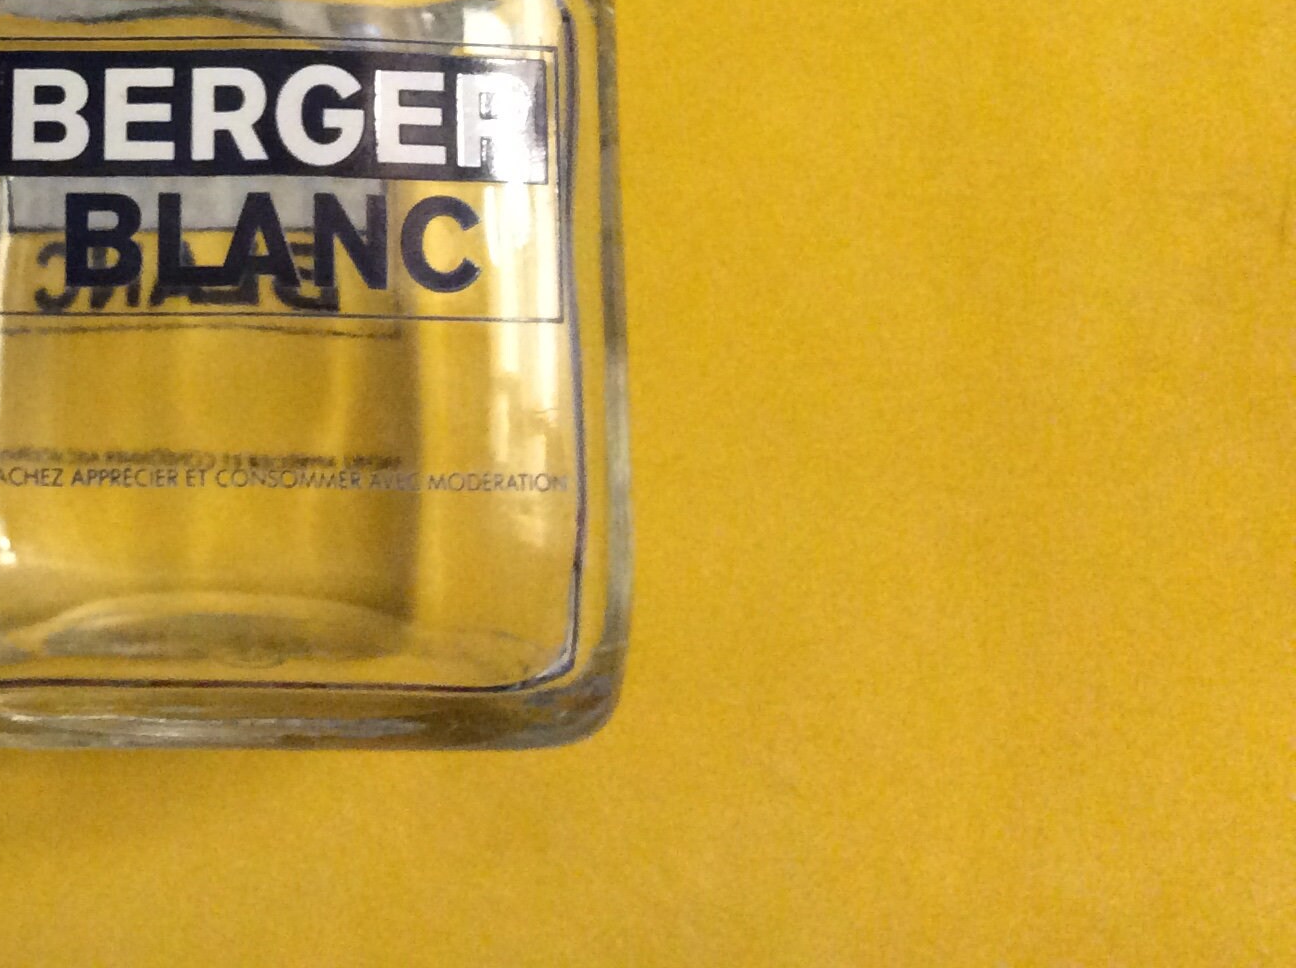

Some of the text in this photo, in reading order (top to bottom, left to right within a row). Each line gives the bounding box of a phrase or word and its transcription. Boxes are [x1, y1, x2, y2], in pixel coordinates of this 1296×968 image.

[11, 64, 533, 169] BERGER
[65, 192, 481, 293] BLANC
[186, 468, 207, 487] ET
[215, 468, 360, 489] CONSOMMER
